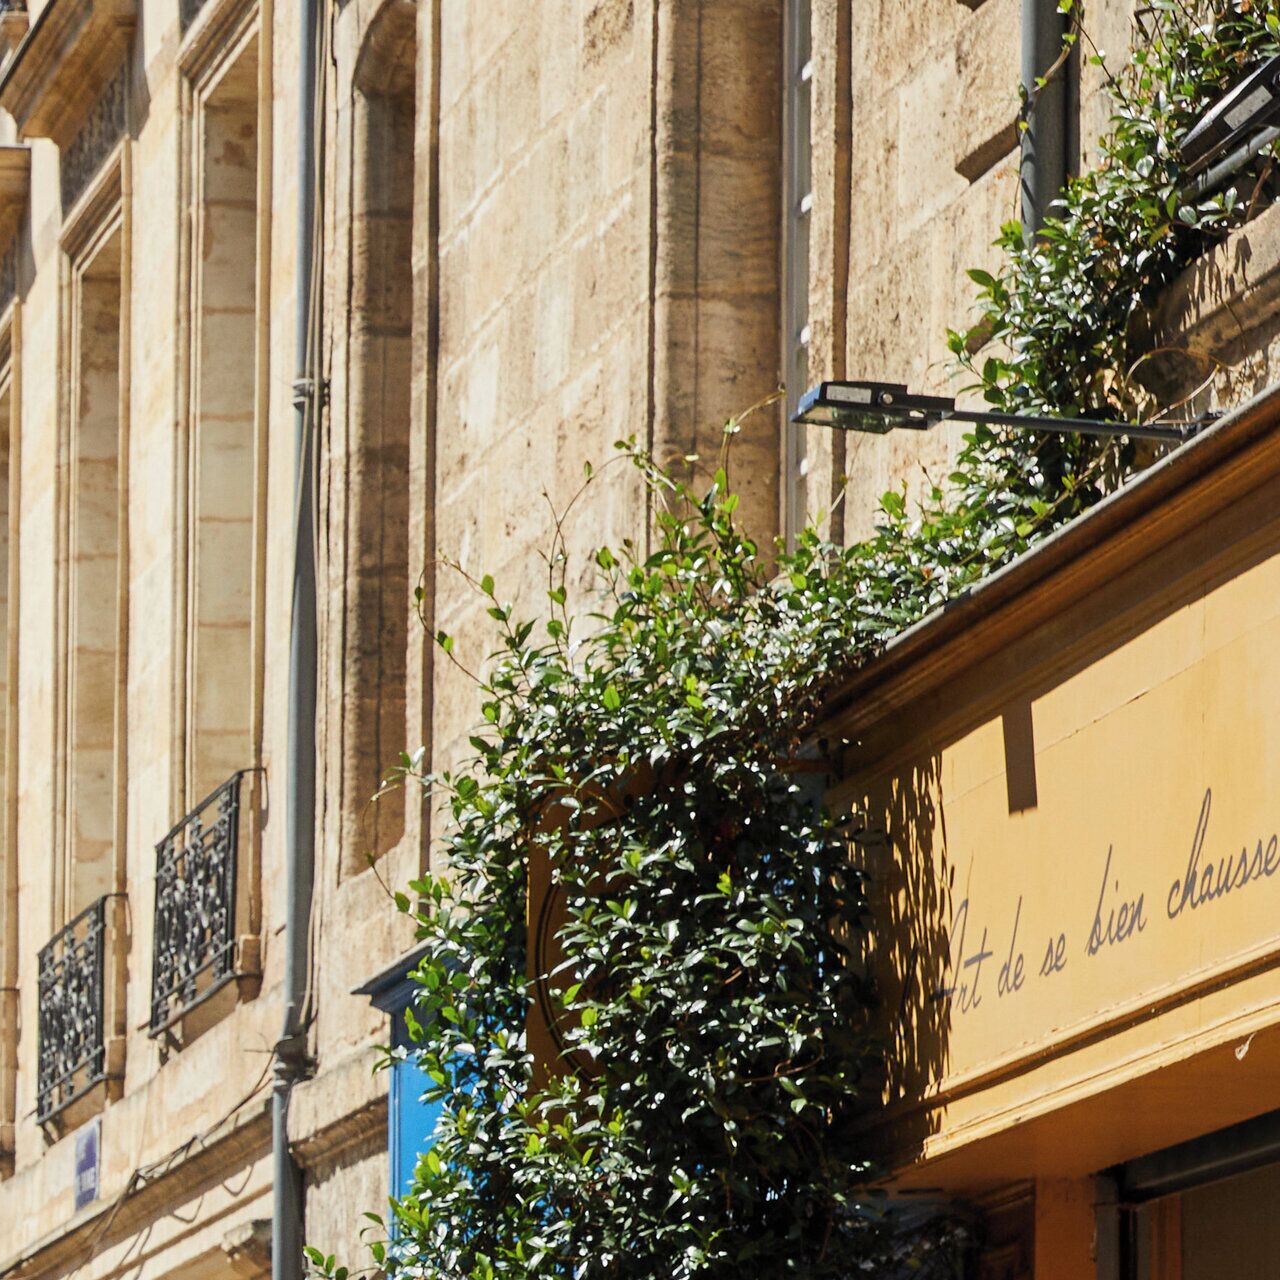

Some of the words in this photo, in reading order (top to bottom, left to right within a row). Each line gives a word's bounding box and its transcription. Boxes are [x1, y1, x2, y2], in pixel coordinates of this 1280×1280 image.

[997, 895, 1025, 998] de
[1039, 933, 1067, 977] se
[1084, 844, 1148, 957] bien
